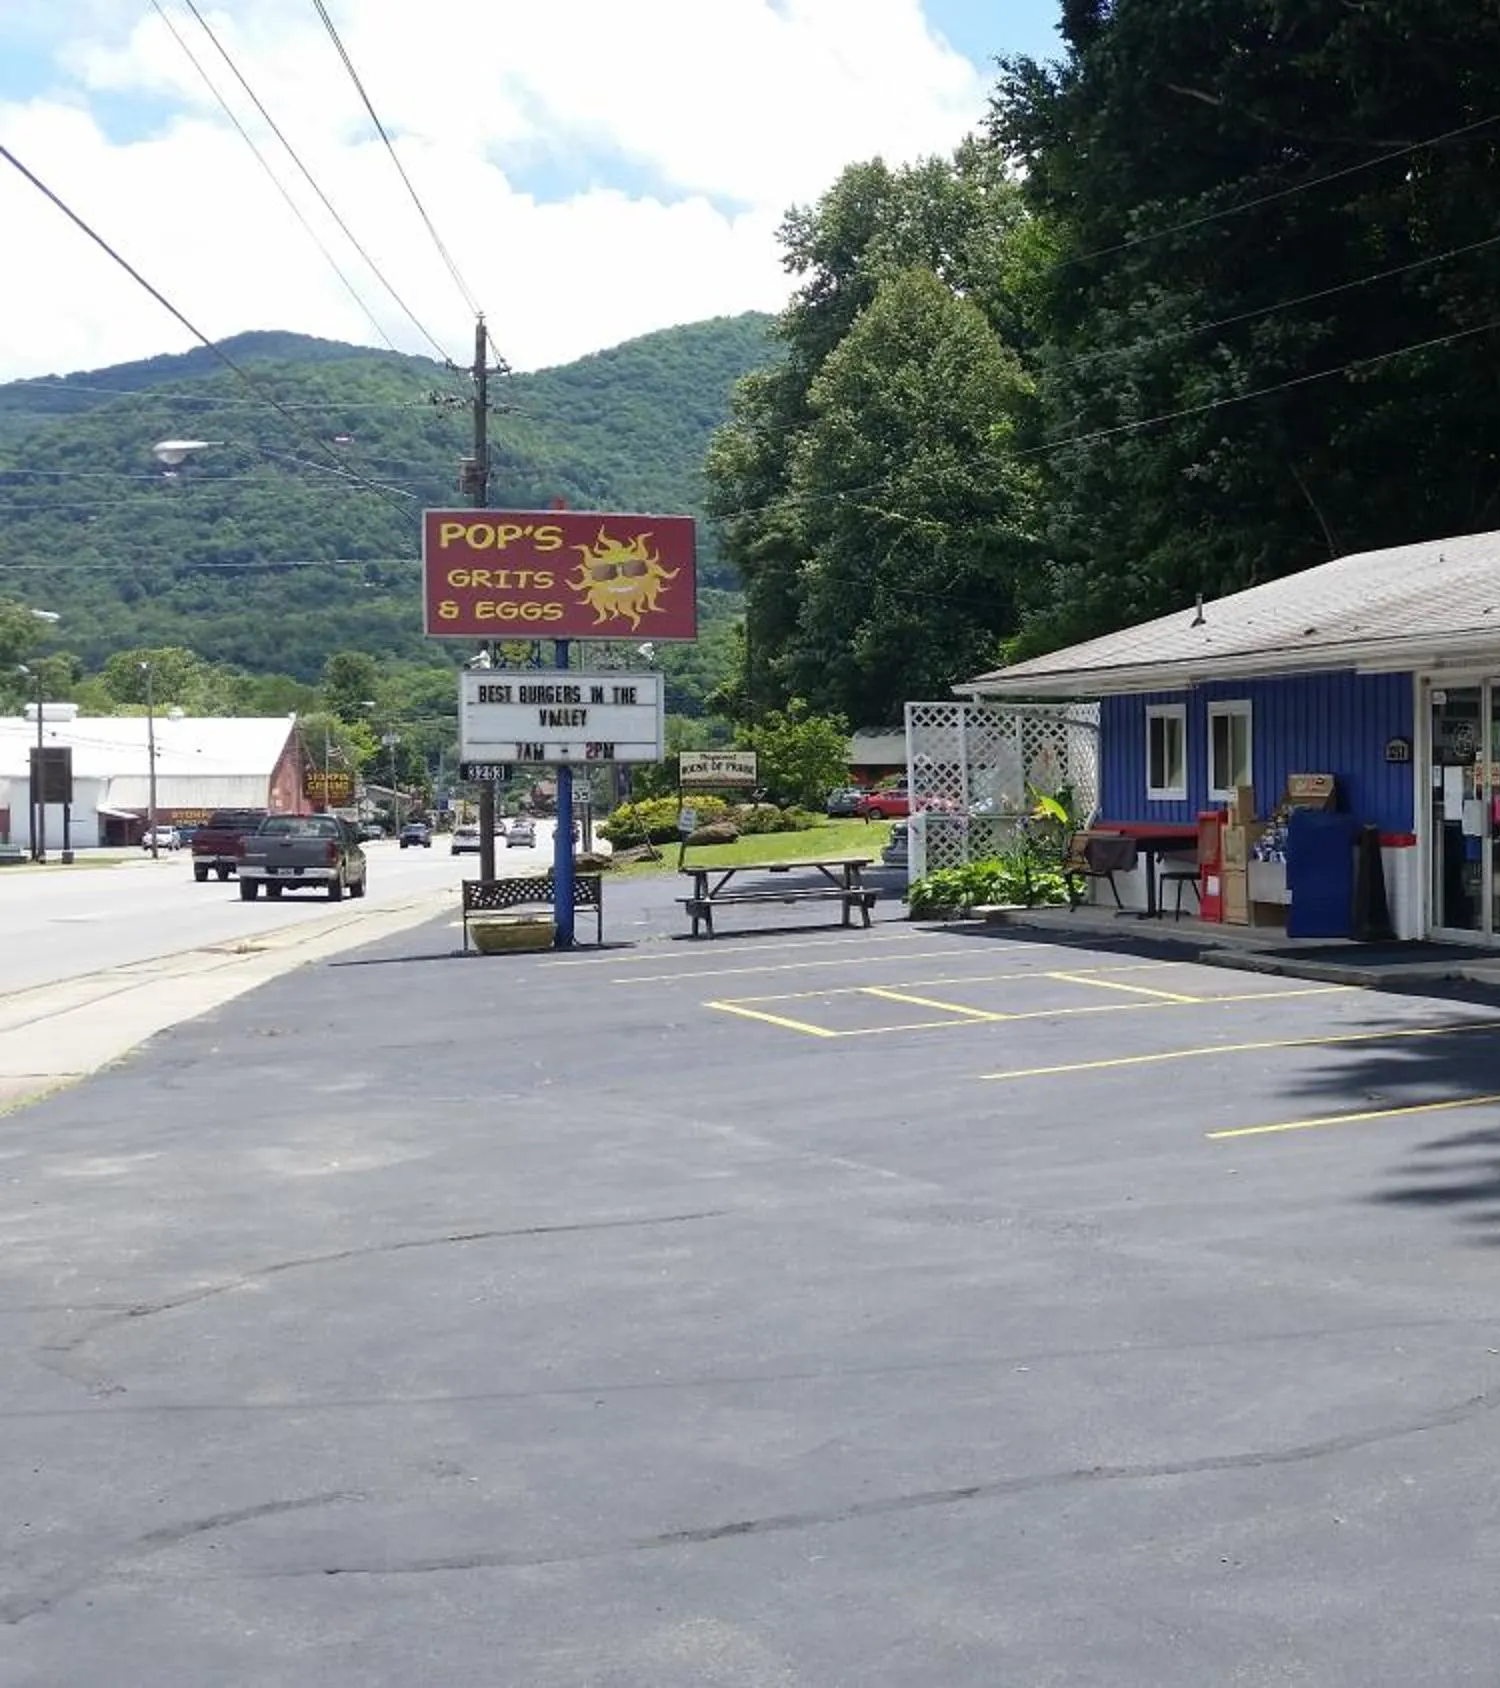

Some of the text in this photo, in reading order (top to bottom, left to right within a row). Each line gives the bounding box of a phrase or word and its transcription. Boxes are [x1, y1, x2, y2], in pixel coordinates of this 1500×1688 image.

[440, 523, 564, 550] POP'S
[447, 568, 554, 589] GRITS
[438, 601, 565, 621] & EGGS
[478, 685, 637, 704] BEST BURGERS IN THE
[515, 743, 545, 760] 7AM
[585, 745, 615, 760] 2PM
